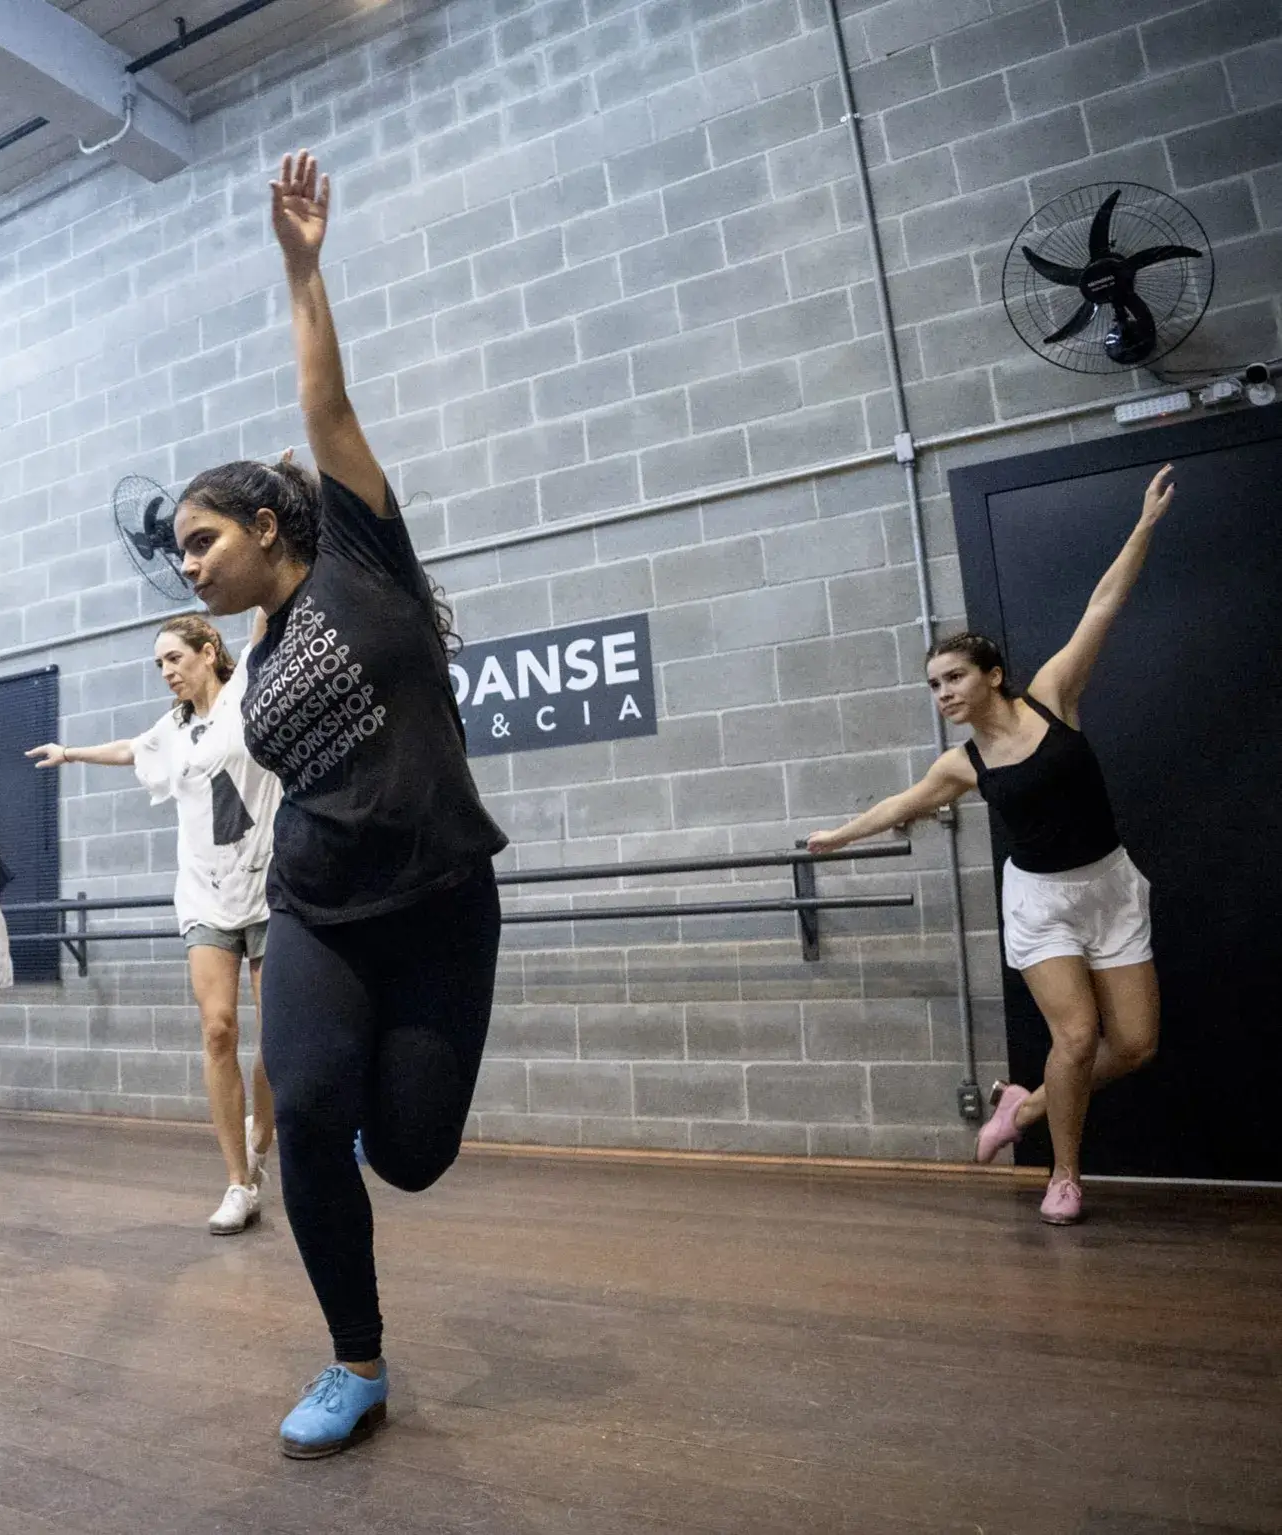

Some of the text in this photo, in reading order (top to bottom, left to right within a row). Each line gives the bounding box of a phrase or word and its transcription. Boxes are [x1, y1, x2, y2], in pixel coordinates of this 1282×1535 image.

[249, 628, 338, 721] WORKSHOP
[252, 644, 351, 740] WORKSHOP
[263, 663, 363, 755] WORKSHOP
[282, 684, 375, 770] WORKSHOP
[298, 704, 387, 791] WORKSHOP
[491, 713, 511, 738] &
